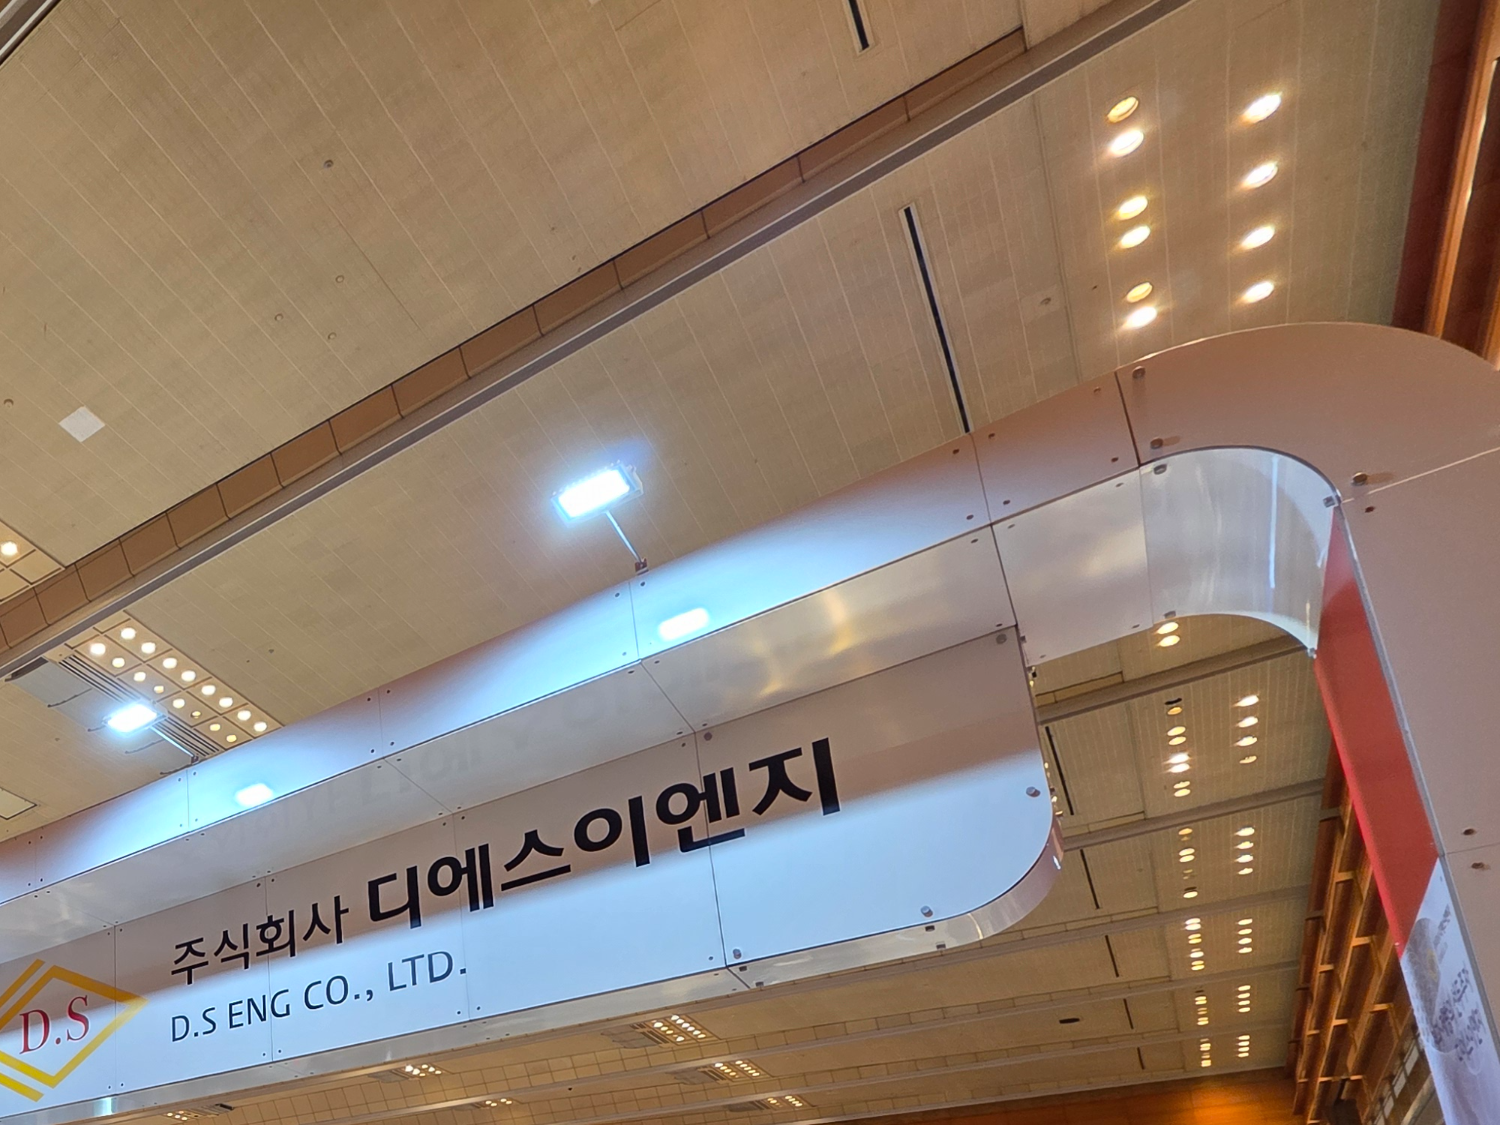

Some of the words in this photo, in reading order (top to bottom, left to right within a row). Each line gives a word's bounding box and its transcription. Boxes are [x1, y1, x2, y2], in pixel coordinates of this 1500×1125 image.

[171, 895, 349, 985] 주식회사
[367, 737, 843, 929] 디에스이엔지
[19, 994, 91, 1056] D.S
[169, 1007, 219, 1043] D.S
[227, 988, 291, 1030] ENG
[303, 973, 375, 1011] CO.,
[387, 953, 467, 992] LTD.
